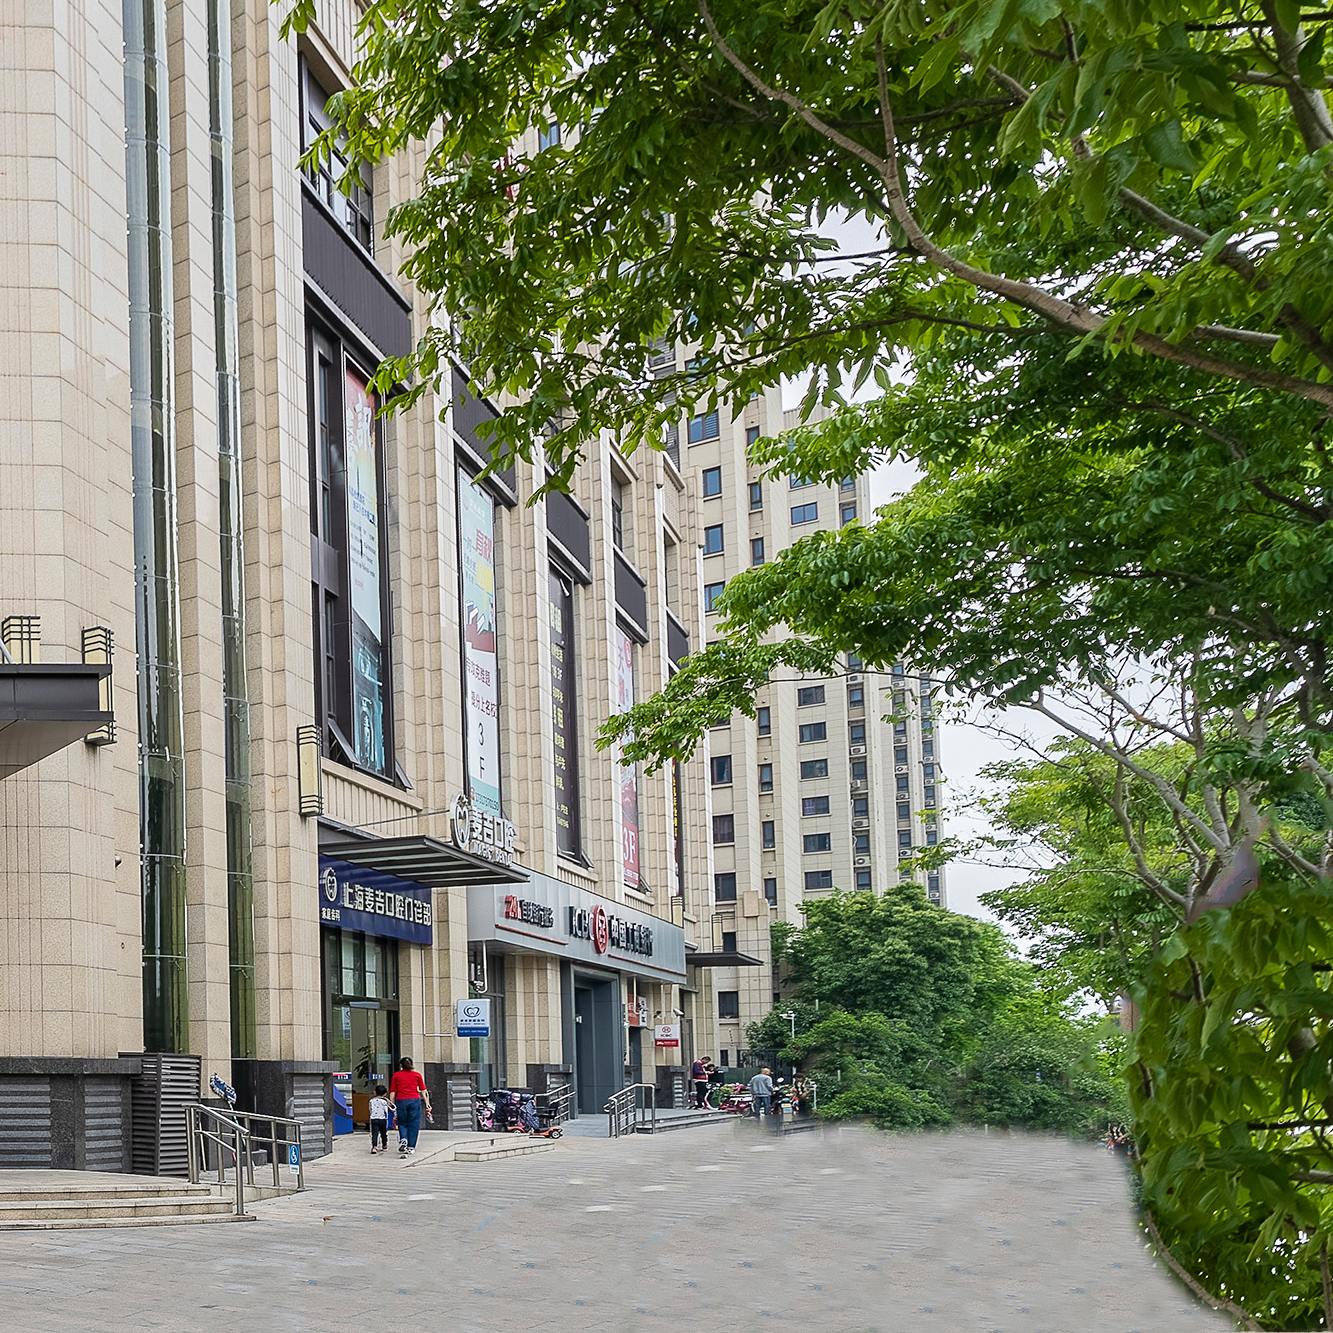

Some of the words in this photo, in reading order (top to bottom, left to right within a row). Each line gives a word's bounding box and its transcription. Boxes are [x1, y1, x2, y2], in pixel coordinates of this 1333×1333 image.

[472, 806, 515, 853] 麦吉口腔
[623, 826, 636, 864] 3F
[343, 881, 432, 926] 上海麦吉口腔门诊部
